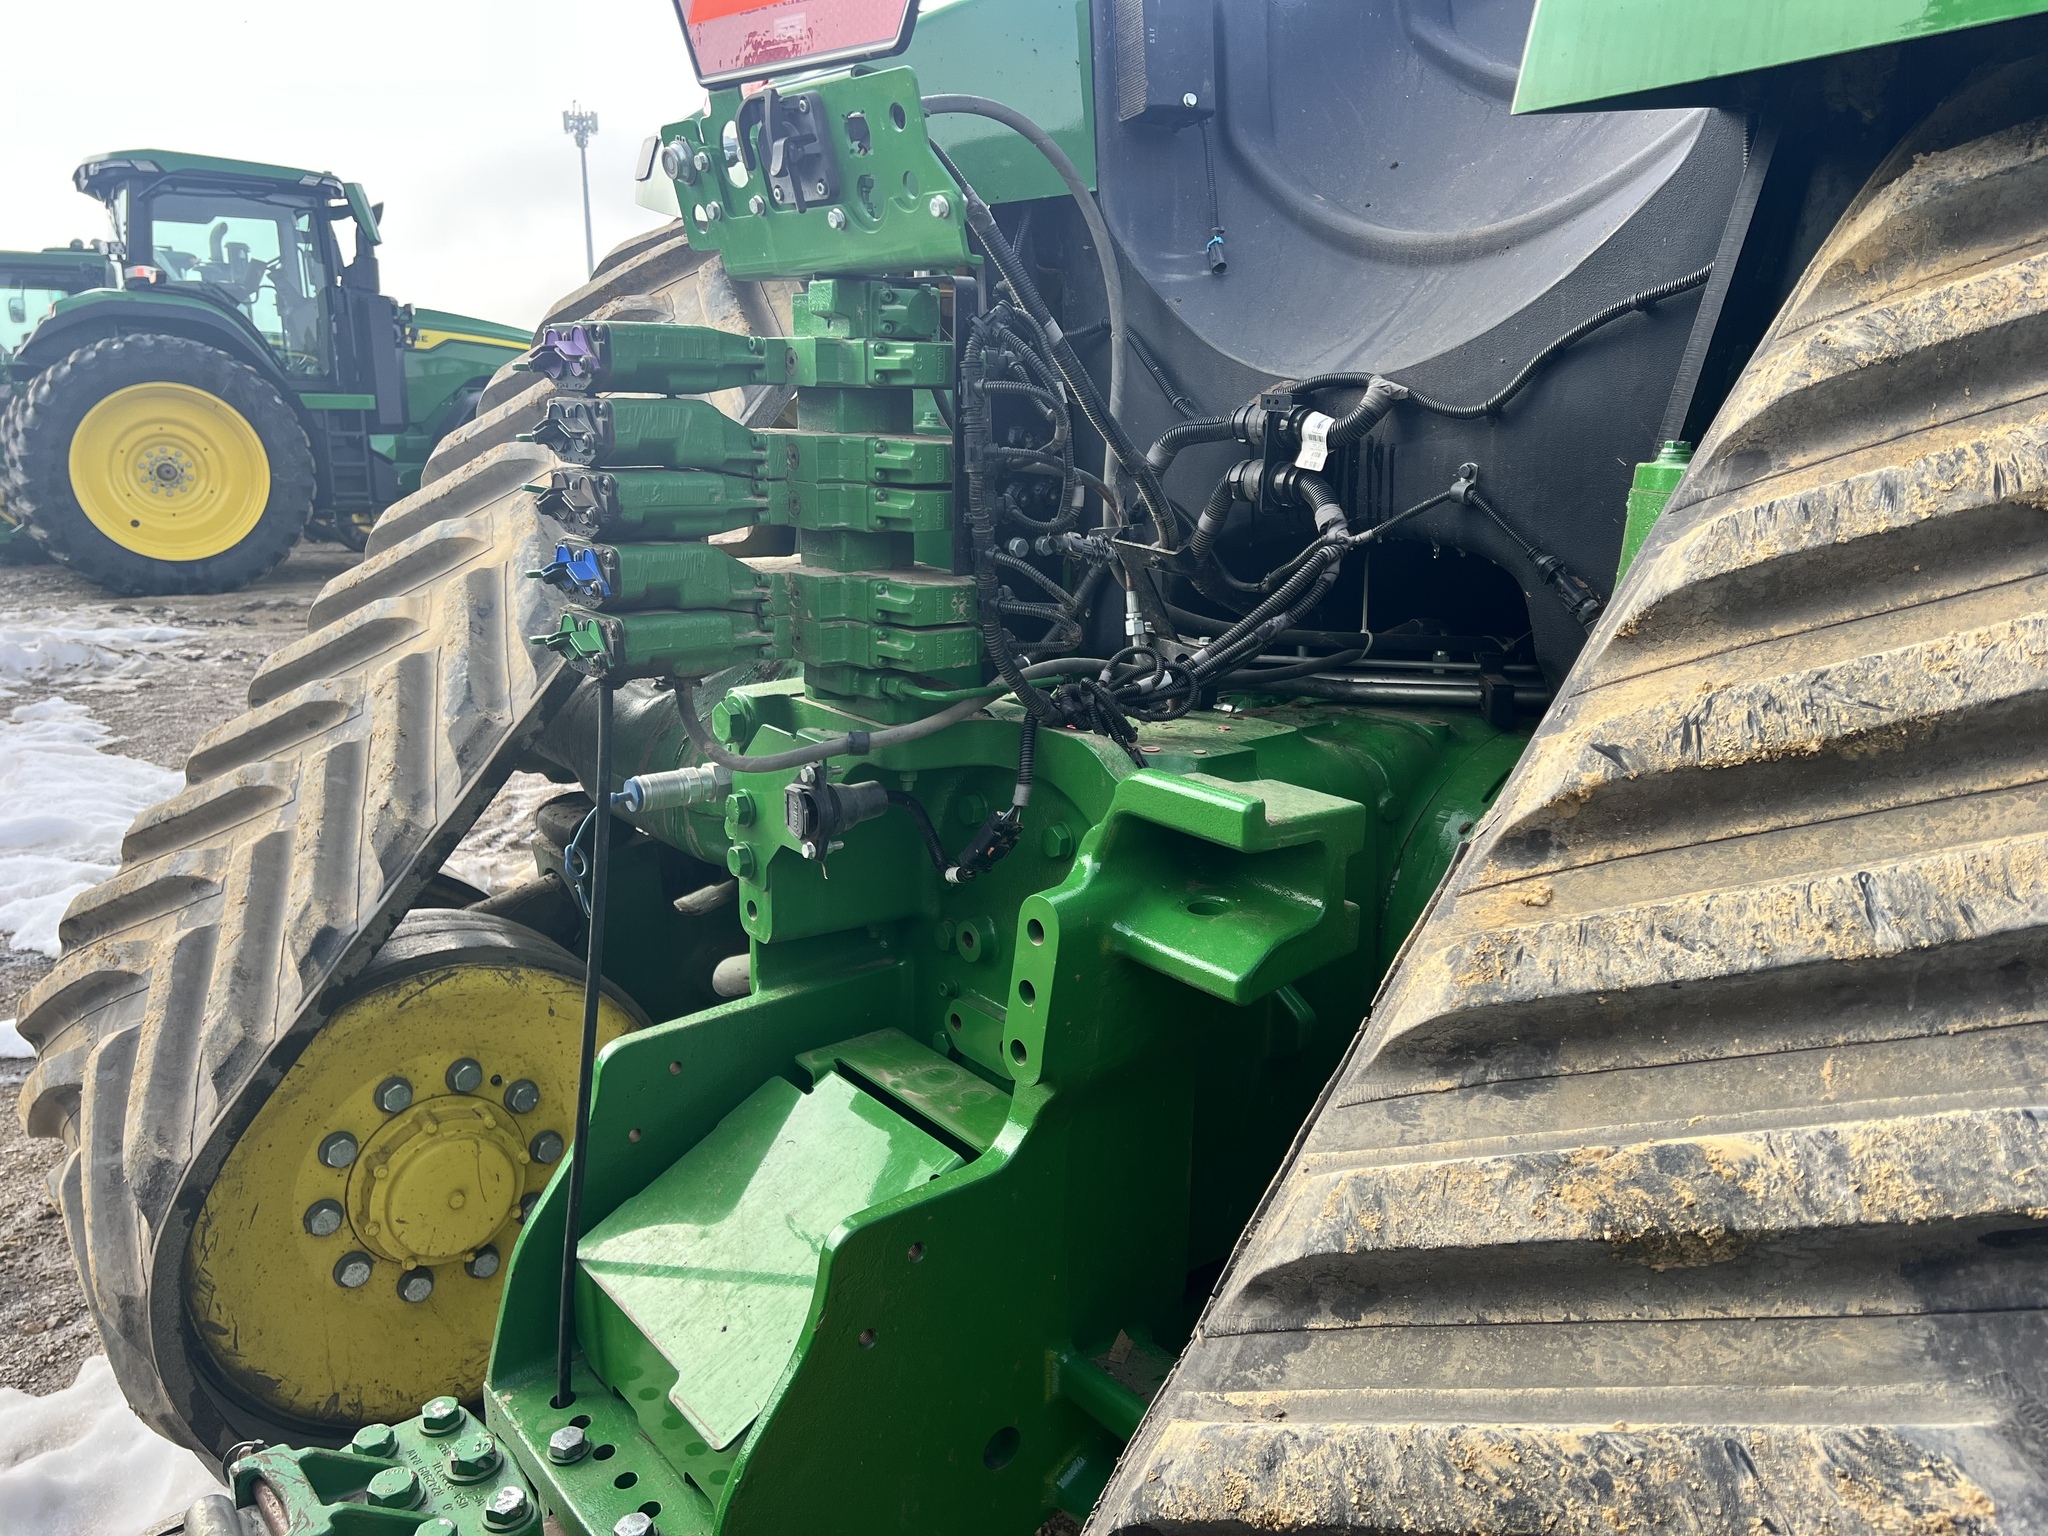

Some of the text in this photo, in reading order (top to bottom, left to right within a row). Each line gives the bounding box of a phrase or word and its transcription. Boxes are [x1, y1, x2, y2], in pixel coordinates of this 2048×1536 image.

[936, 347, 944, 382] Rexroth
[936, 447, 944, 480] Rexroth
[936, 496, 944, 528] Rexroth
[454, 1492, 469, 1509] USA
